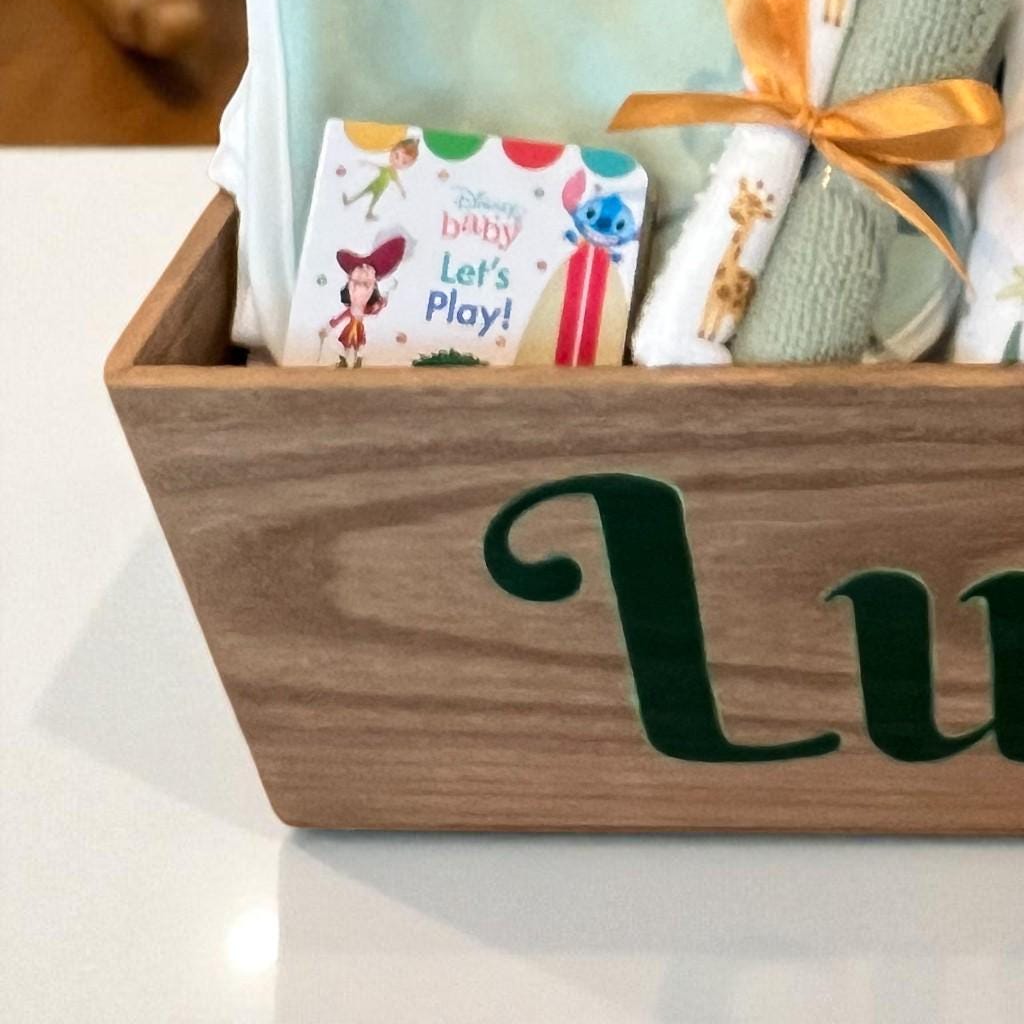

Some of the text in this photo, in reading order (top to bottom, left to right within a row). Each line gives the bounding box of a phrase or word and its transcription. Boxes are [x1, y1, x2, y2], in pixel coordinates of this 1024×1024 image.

[452, 186, 521, 219] Disney
[441, 210, 522, 252] baby
[440, 250, 510, 290] Let's
[425, 287, 512, 337] Play!
